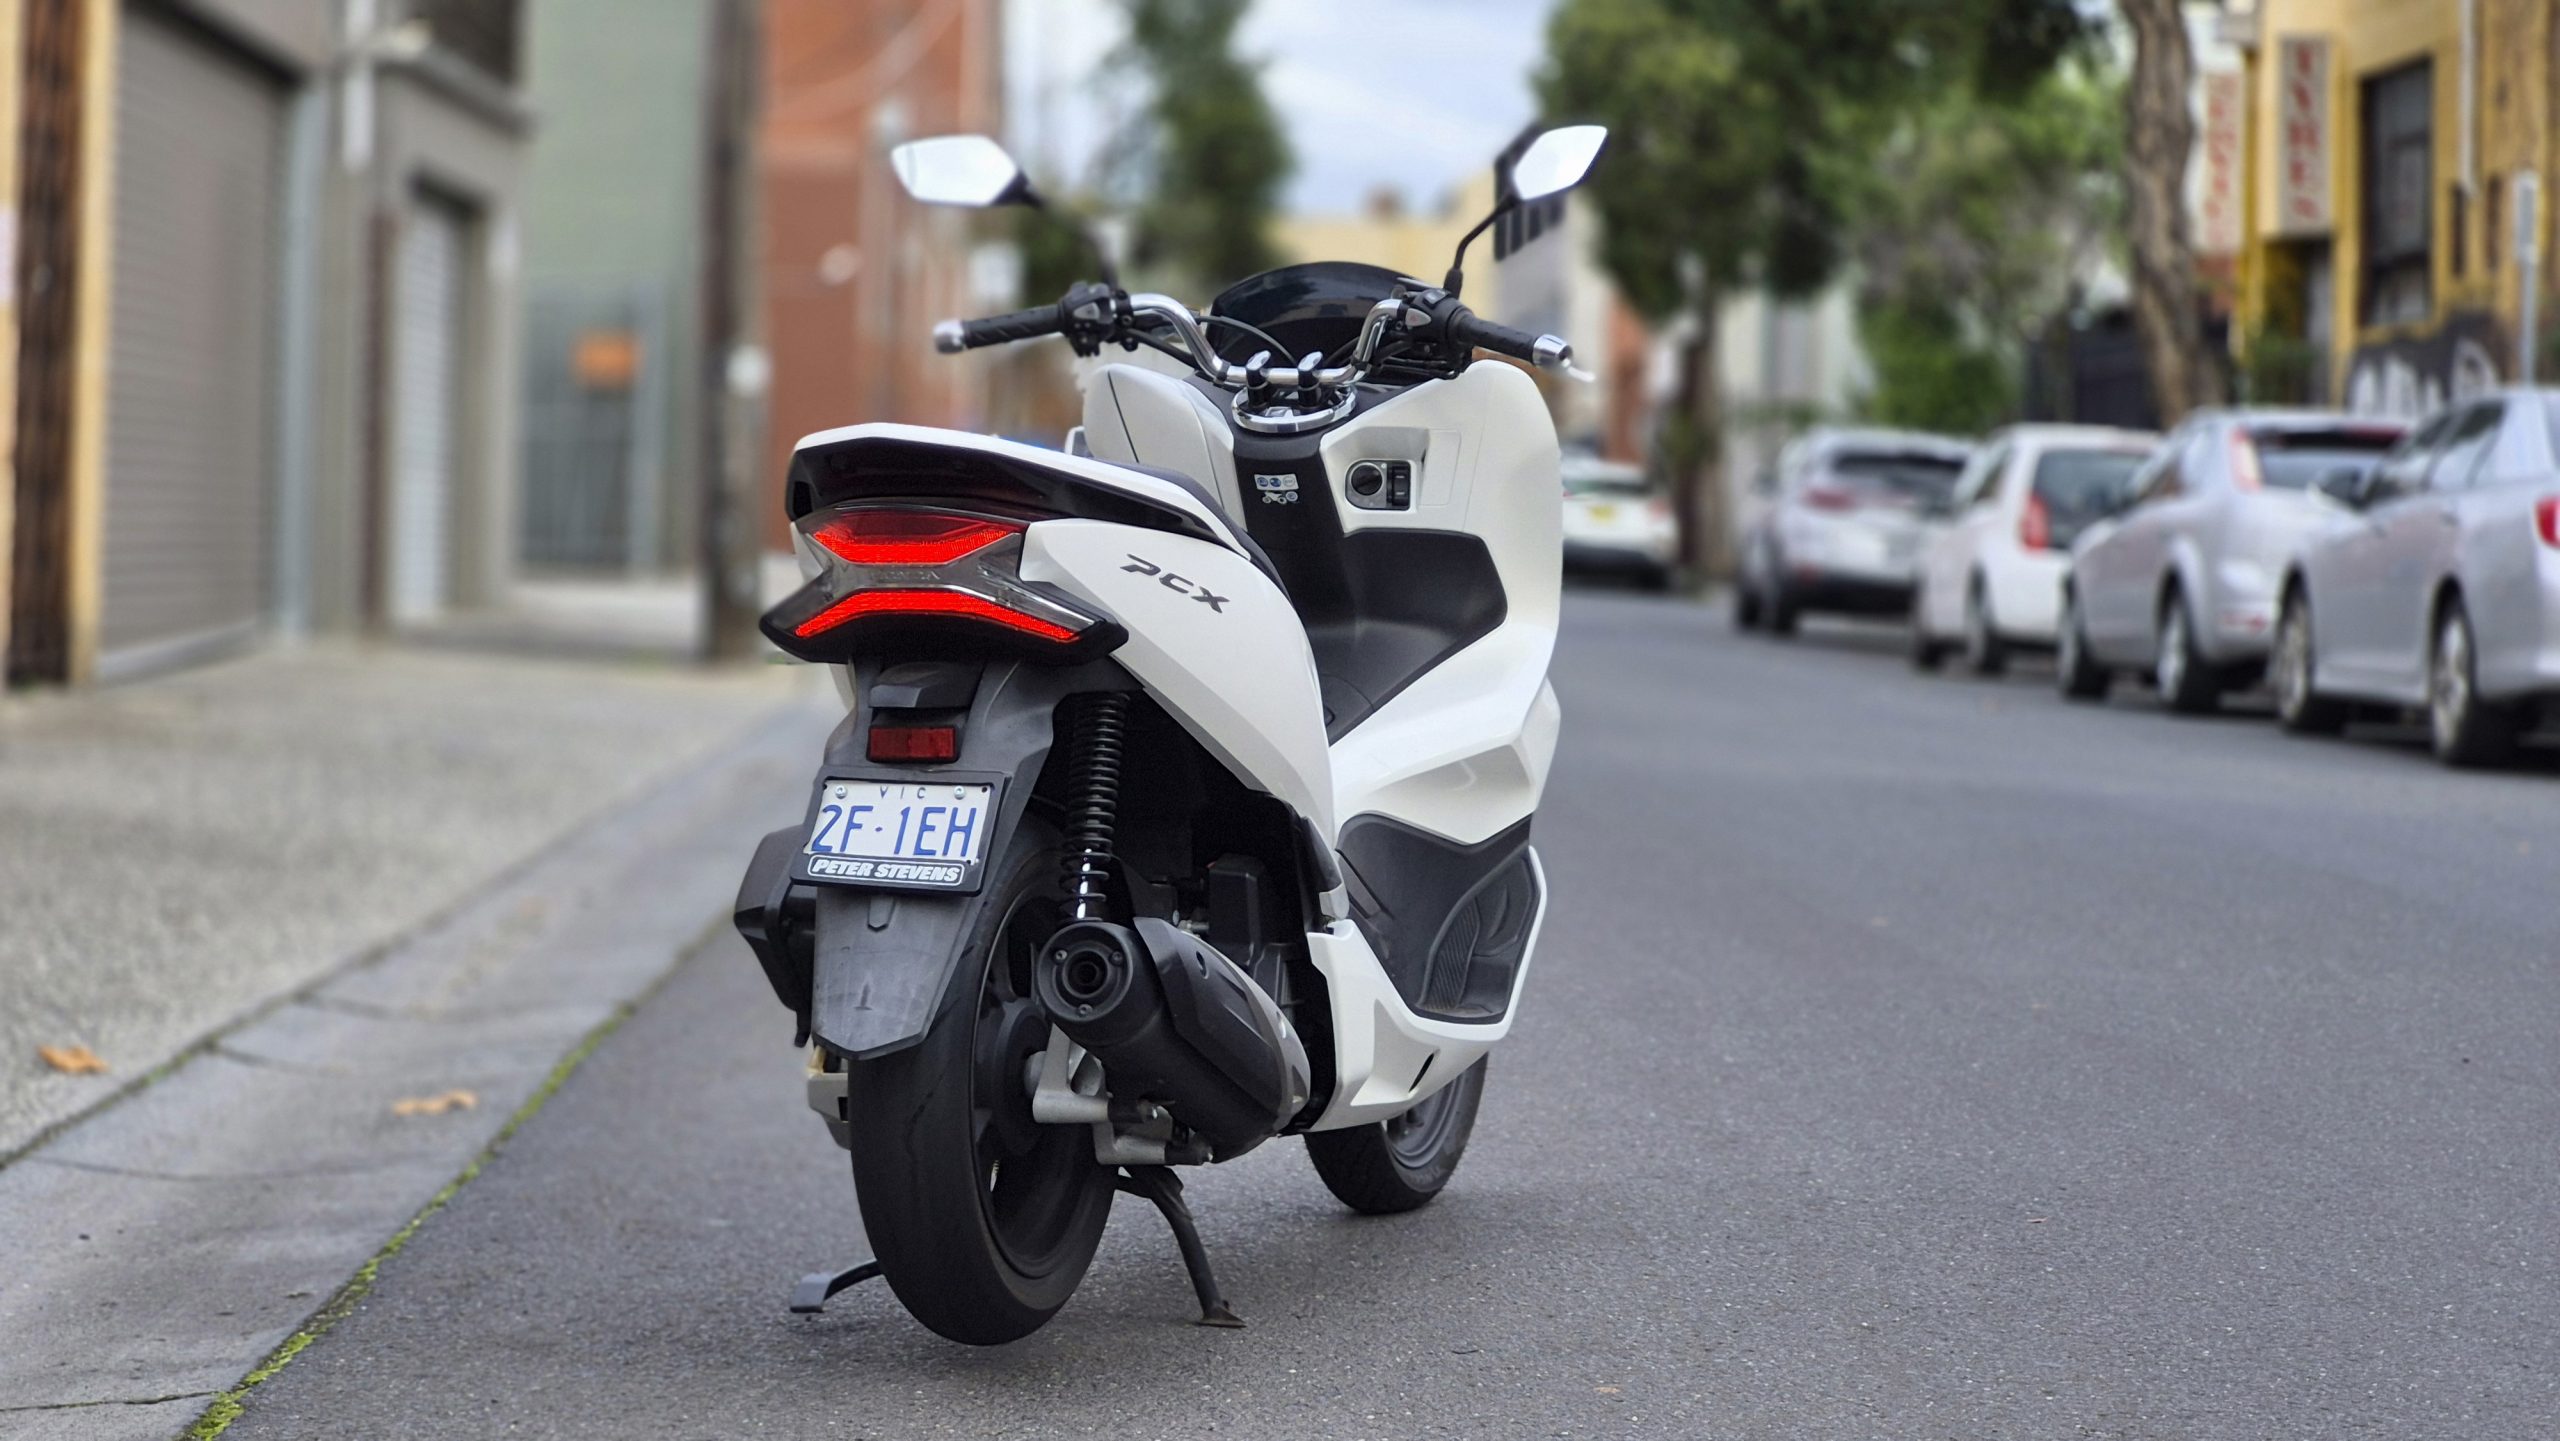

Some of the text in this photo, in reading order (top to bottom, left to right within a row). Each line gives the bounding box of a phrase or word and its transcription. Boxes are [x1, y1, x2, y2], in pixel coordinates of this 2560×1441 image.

[1120, 553, 1230, 613] PCX
[879, 786, 926, 799] VIC
[812, 859, 960, 882] PETER STEVENS
